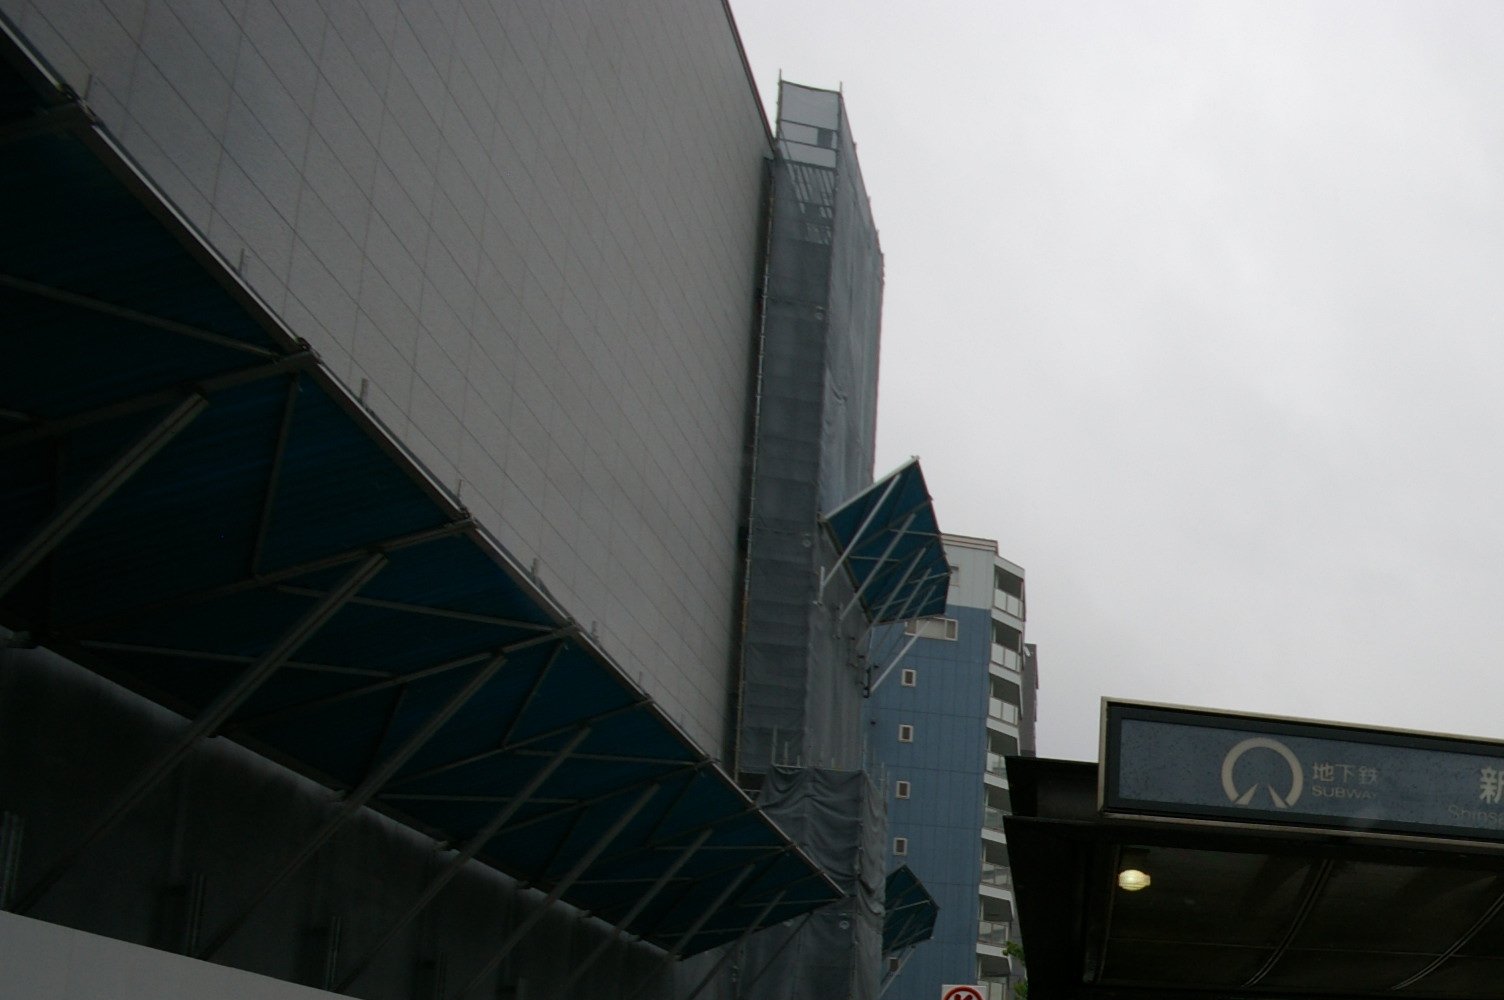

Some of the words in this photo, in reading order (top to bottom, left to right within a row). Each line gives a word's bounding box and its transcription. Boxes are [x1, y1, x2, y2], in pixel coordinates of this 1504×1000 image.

[1311, 761, 1379, 786] 地下鉄
[1311, 784, 1378, 801] SUBWAY
